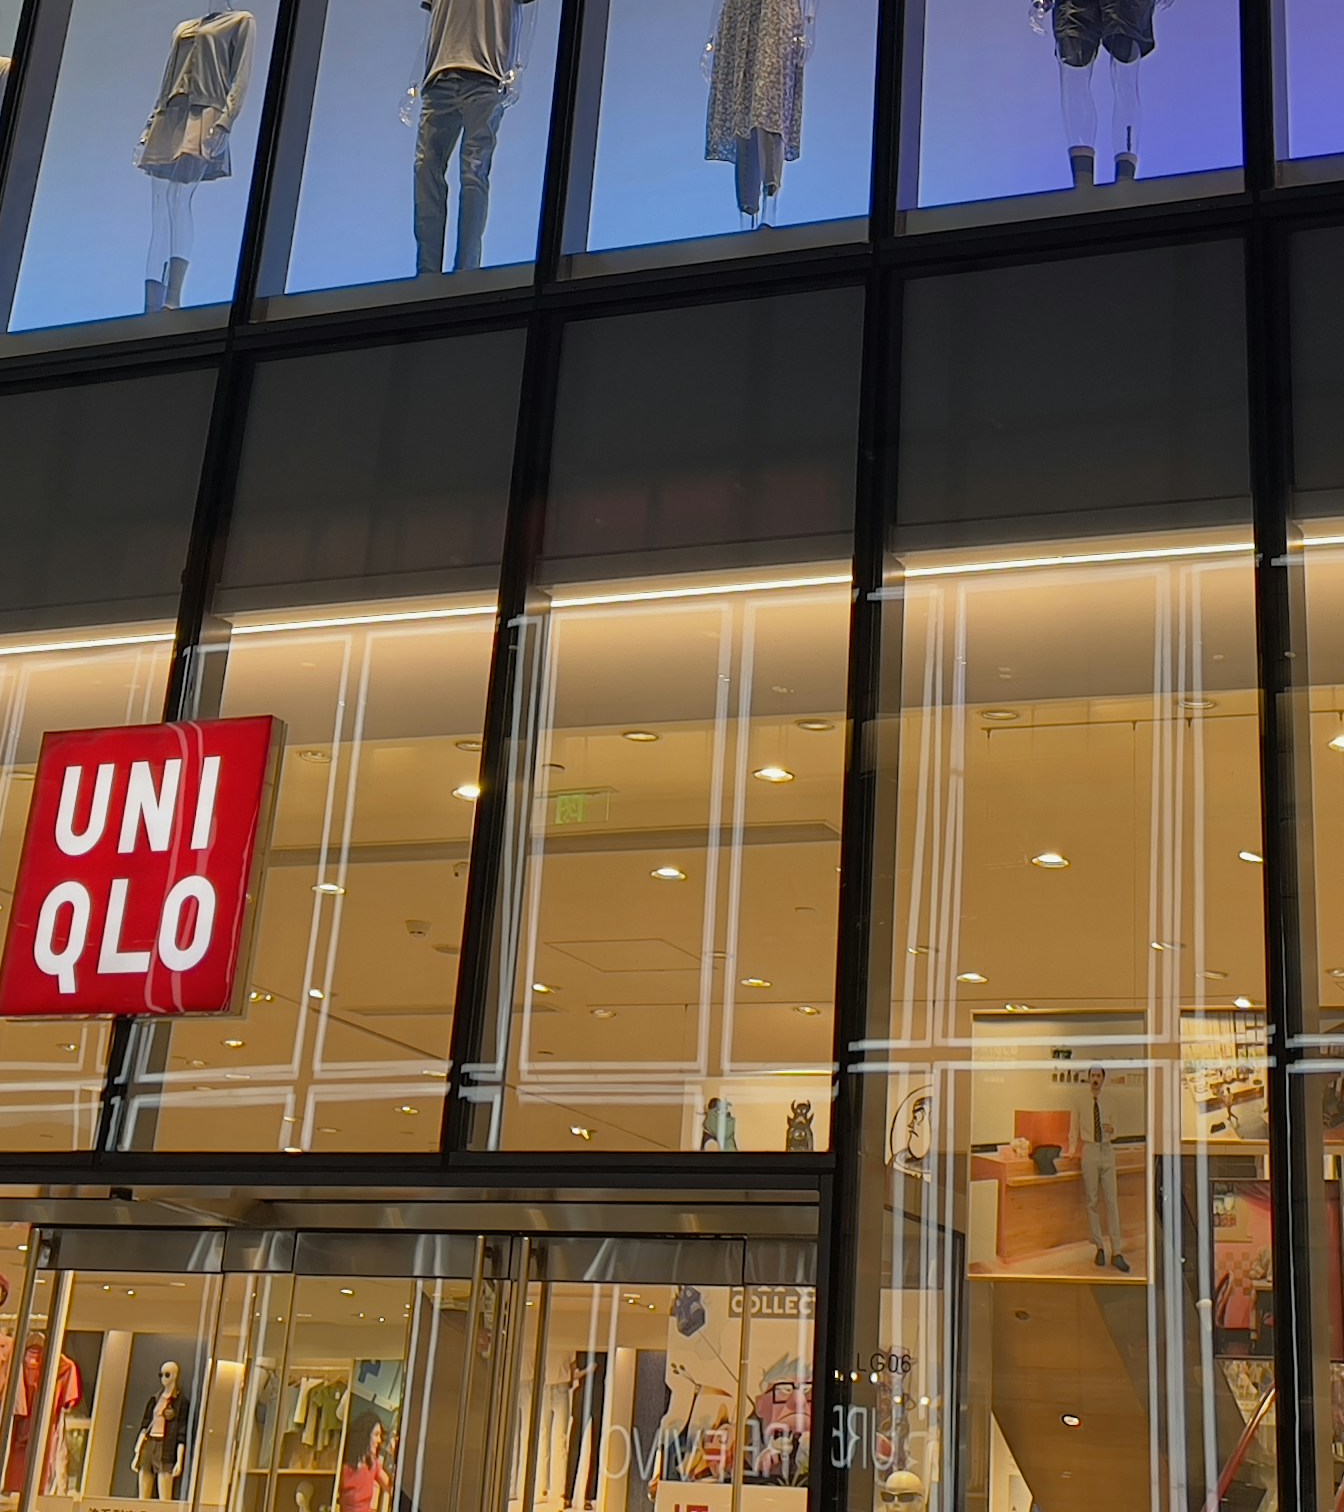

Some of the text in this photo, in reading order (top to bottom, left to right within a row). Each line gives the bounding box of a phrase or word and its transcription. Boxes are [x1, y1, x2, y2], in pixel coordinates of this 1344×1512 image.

[55, 756, 221, 856] UNI
[33, 875, 216, 994] QLO
[731, 1295, 816, 1315] COLLEC
[857, 1353, 912, 1374] LG06
